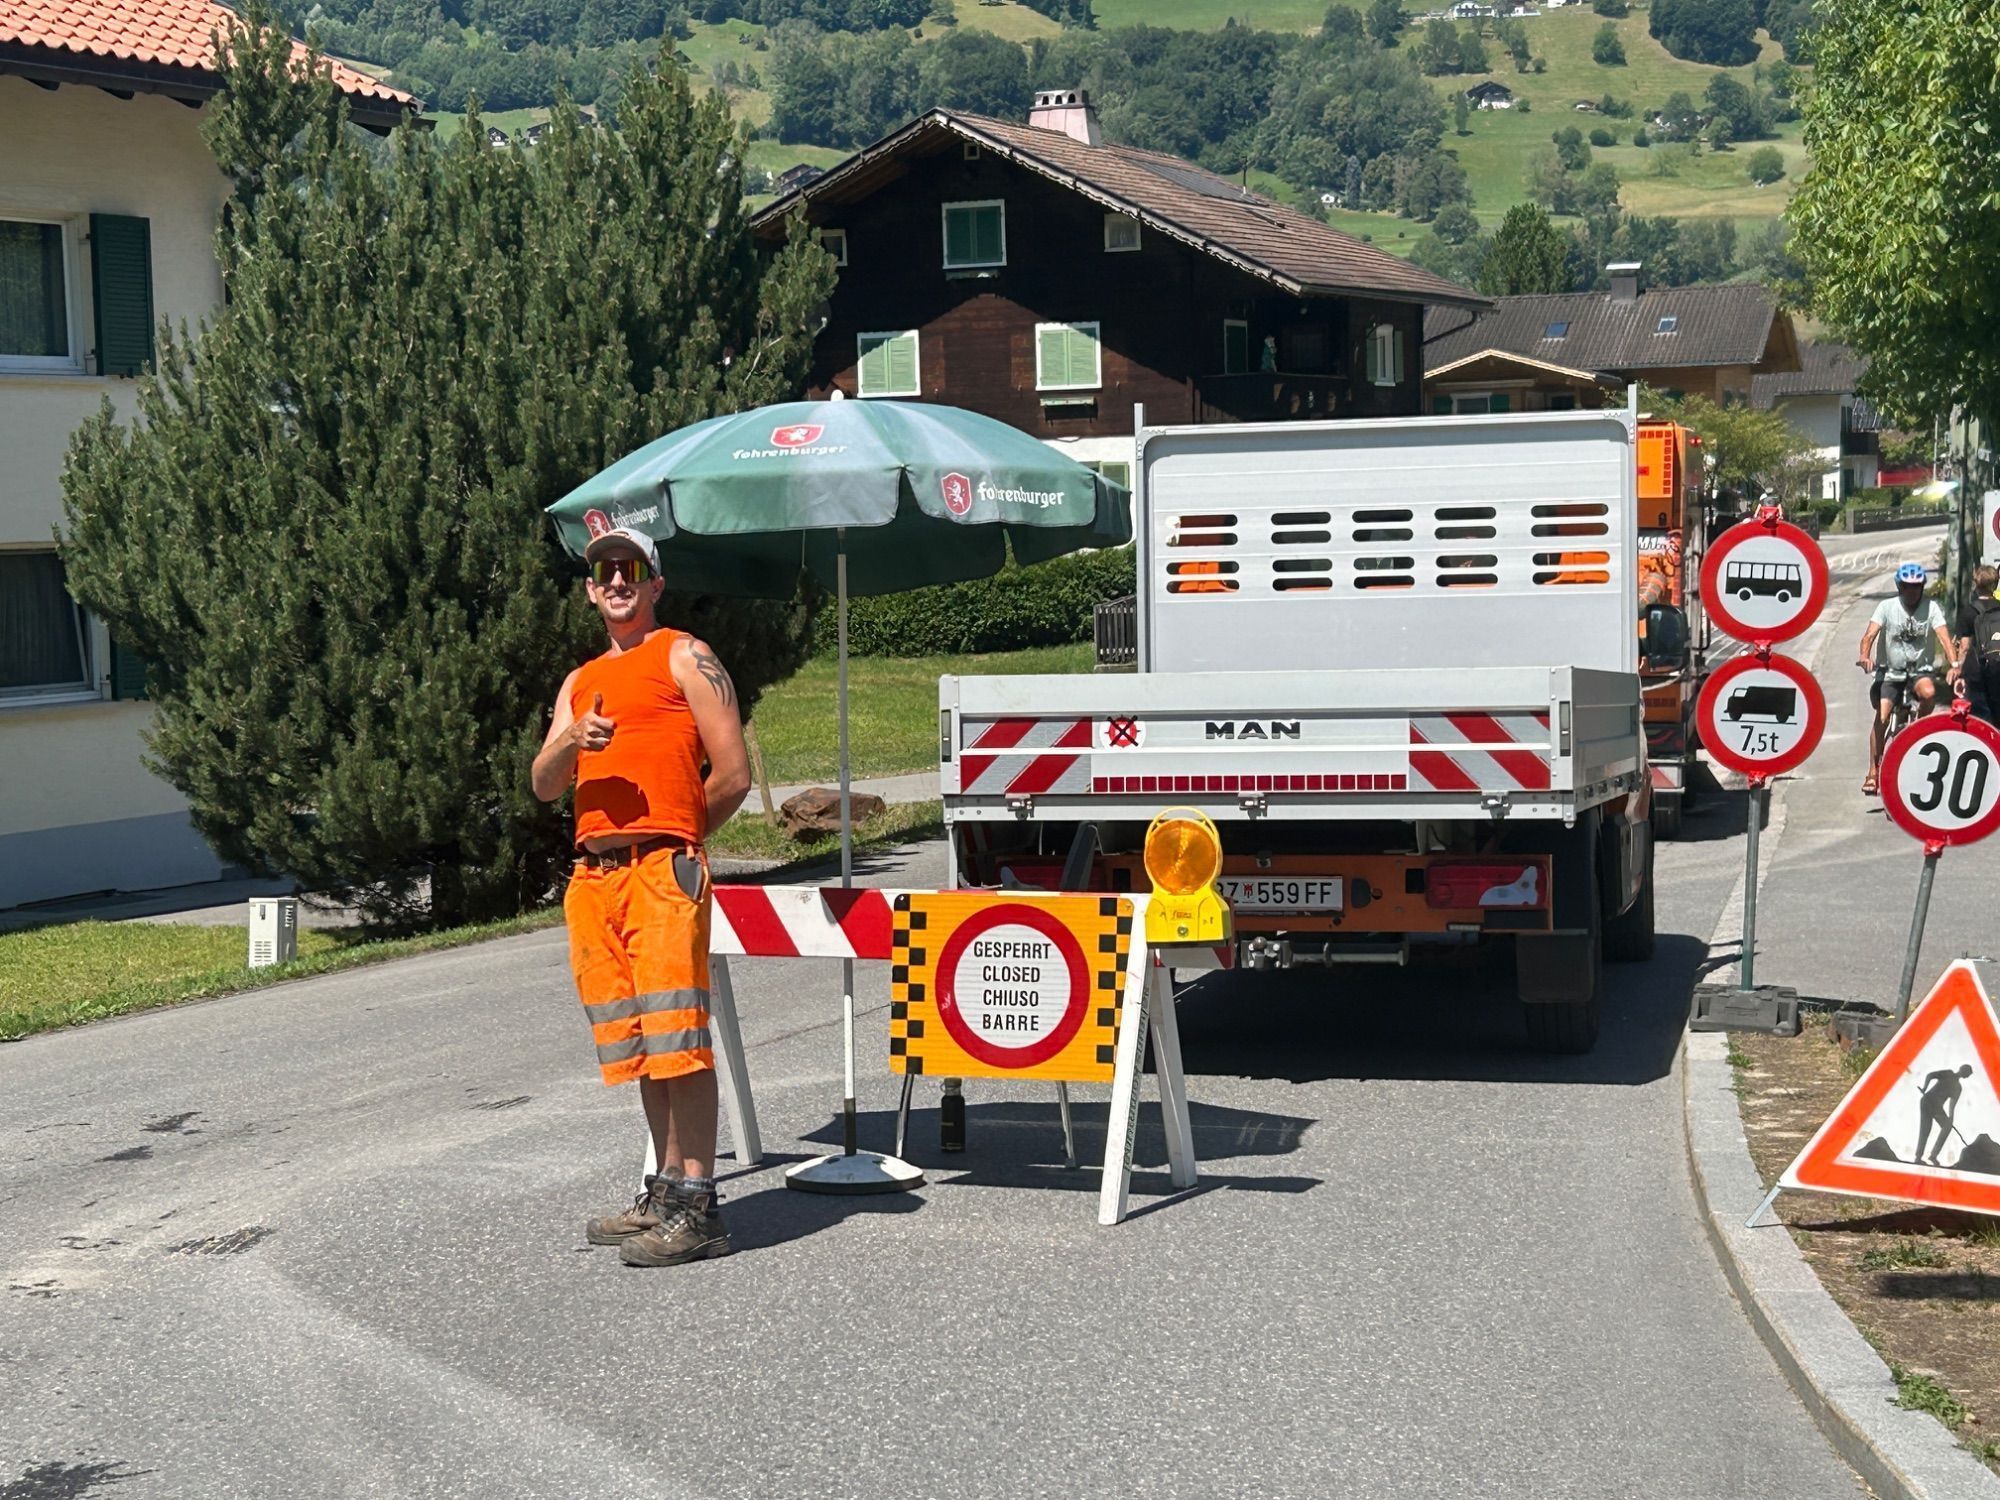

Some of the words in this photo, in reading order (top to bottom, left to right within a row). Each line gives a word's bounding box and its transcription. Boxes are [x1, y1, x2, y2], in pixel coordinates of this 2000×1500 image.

[1205, 721, 1301, 740] MAN
[1909, 742, 1990, 819] 30
[973, 941, 1052, 959] GESPERRT
[983, 965, 1040, 982] CLOSED
[983, 989, 1039, 1006] CHIUSO
[982, 1013, 1039, 1031] BARRE
